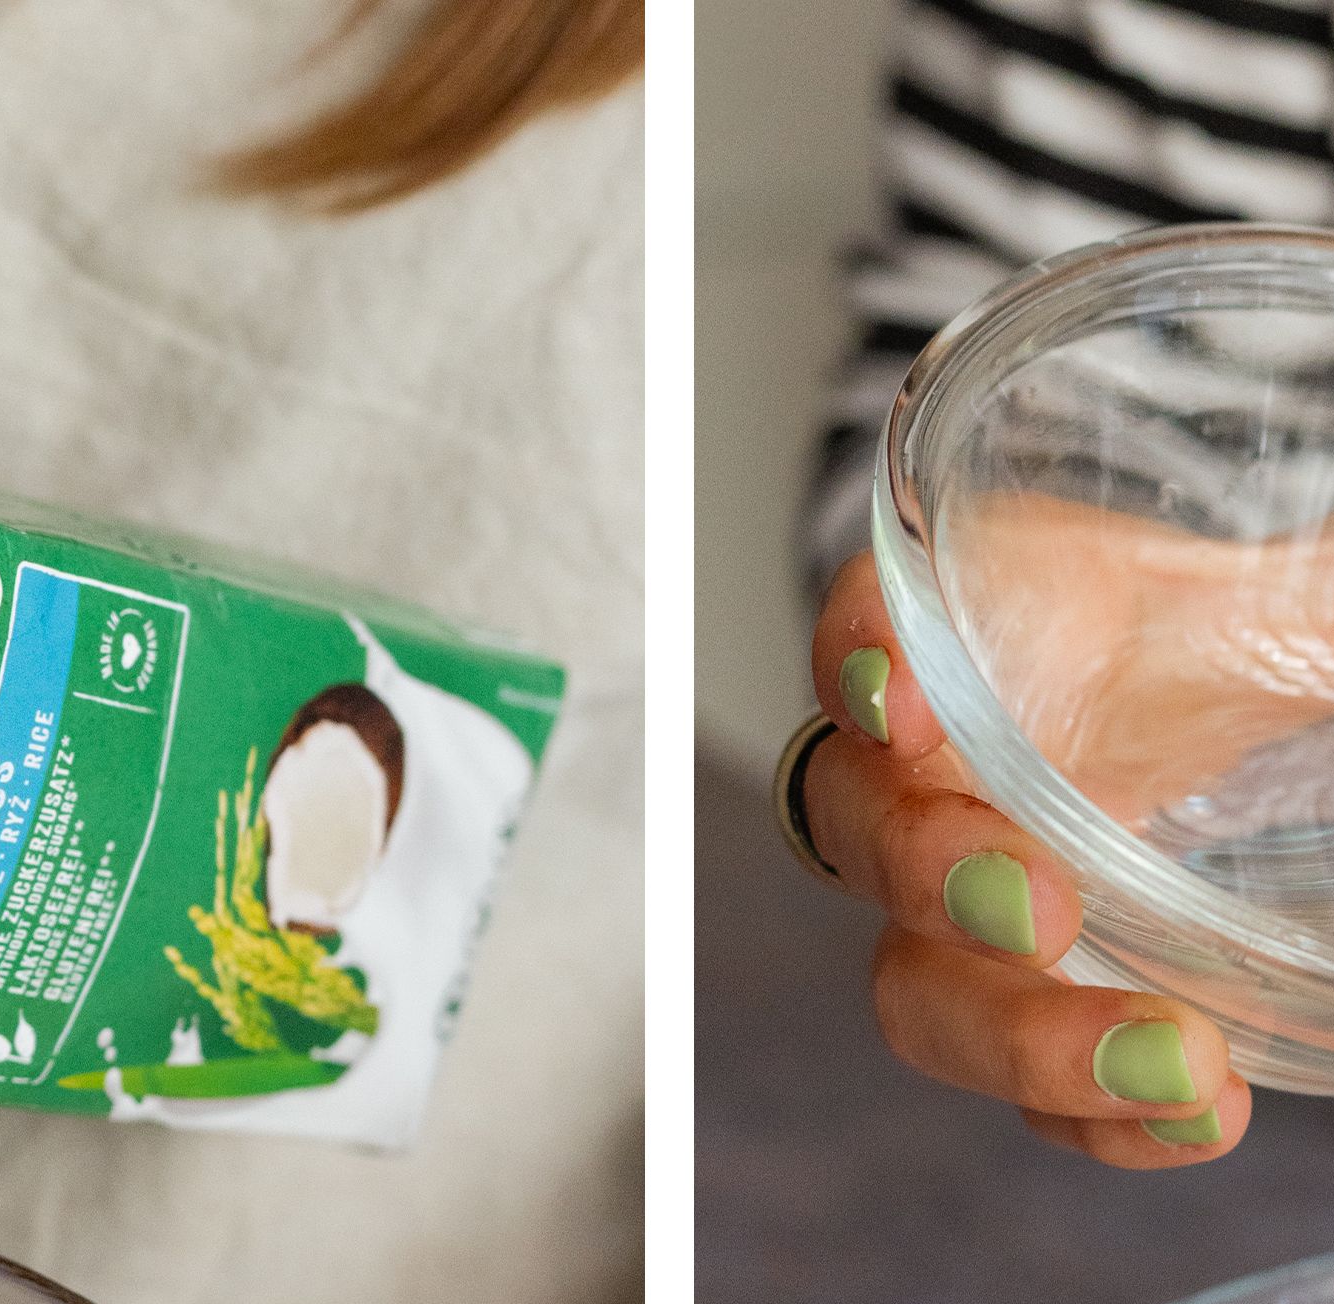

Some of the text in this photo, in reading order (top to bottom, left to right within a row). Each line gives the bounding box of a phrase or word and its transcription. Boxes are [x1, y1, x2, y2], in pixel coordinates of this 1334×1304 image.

[0, 794, 31, 844] RYŻ
[23, 709, 55, 771] RICE
[24, 861, 55, 916] ADDED
